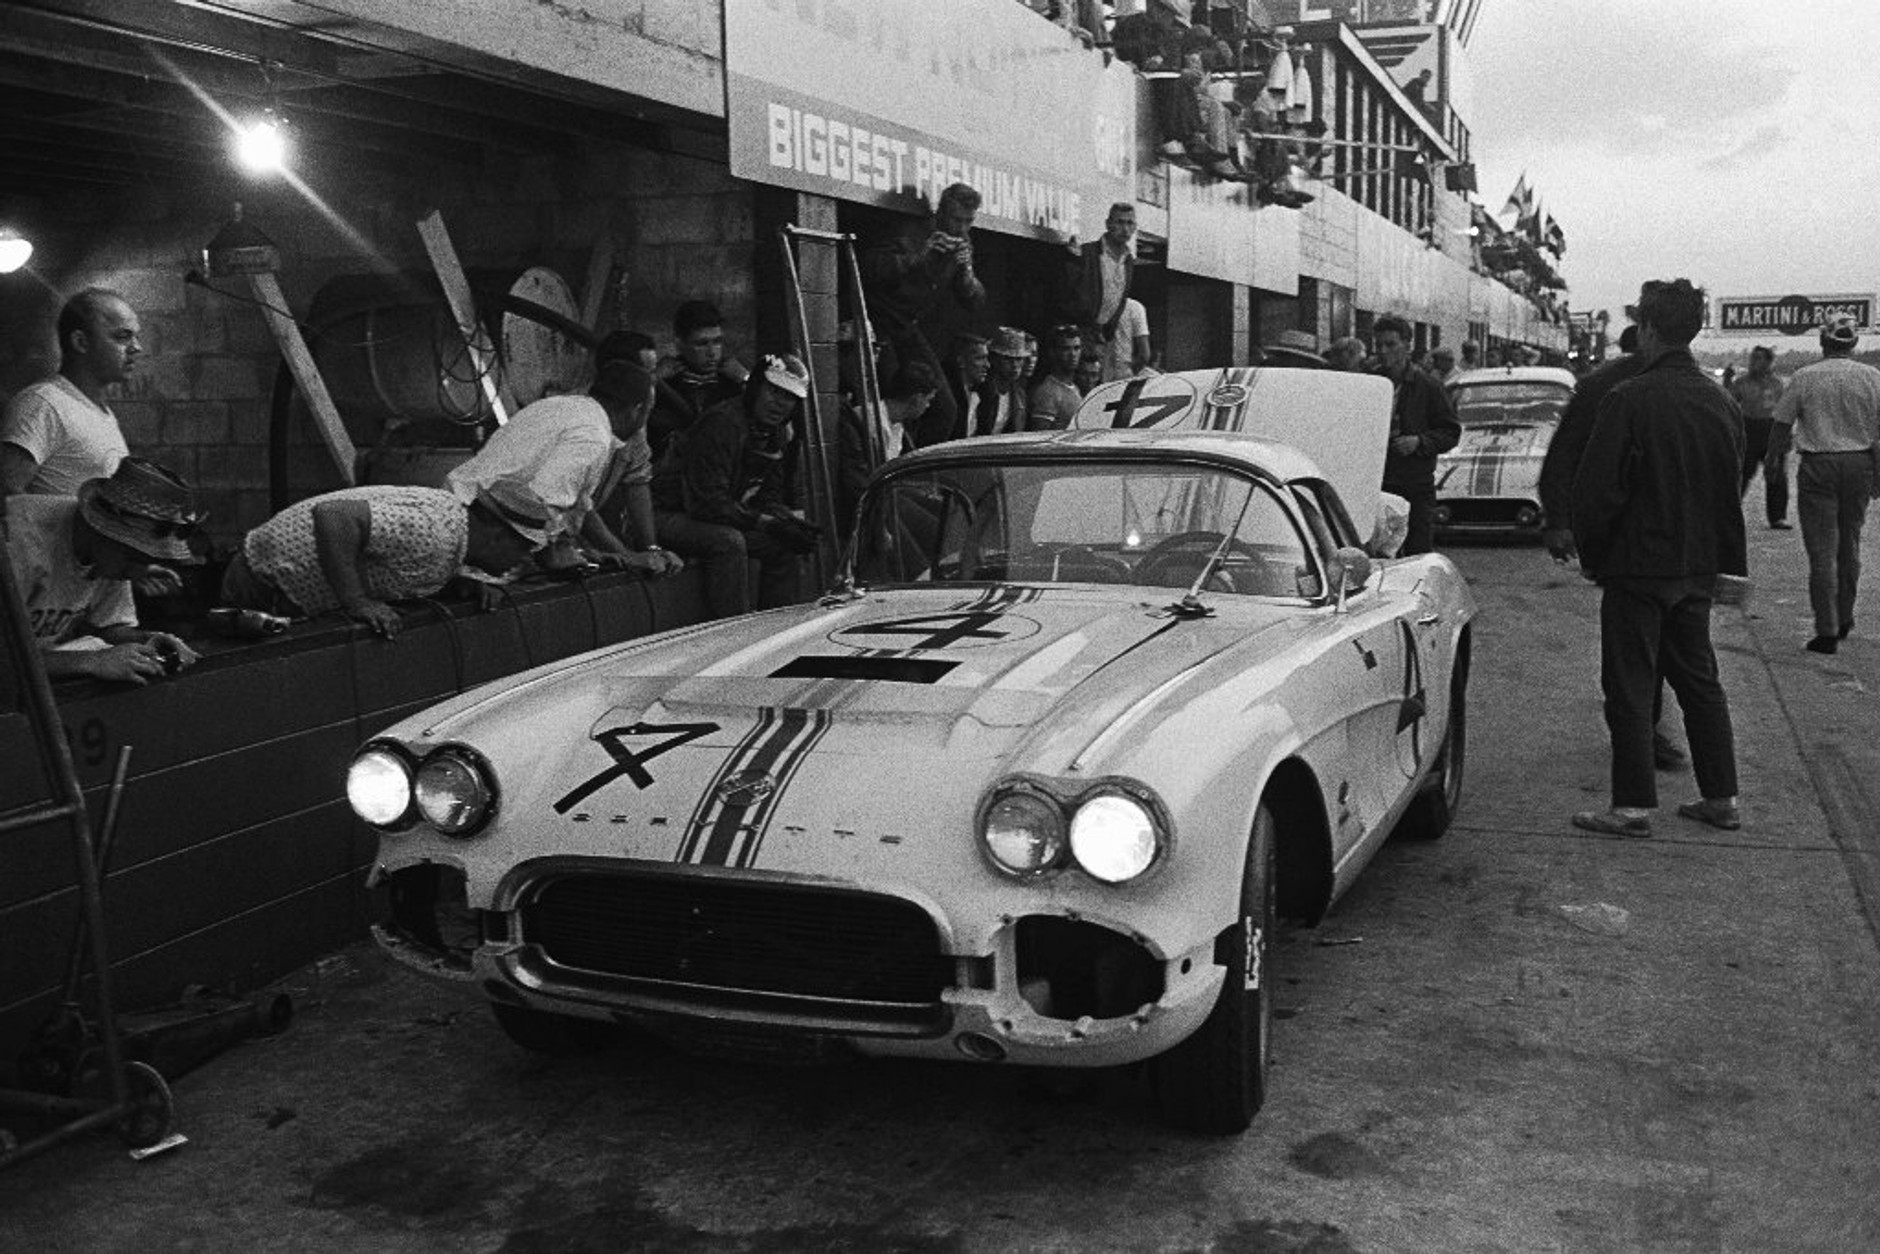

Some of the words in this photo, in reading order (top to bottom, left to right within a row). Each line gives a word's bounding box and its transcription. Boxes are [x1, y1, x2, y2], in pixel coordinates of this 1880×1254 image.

[768, 103, 909, 194] BIGGEST
[1726, 305, 1798, 326] MARTINI
[1103, 377, 1194, 429] 4
[841, 612, 1009, 649] 4
[553, 722, 721, 815] 4
